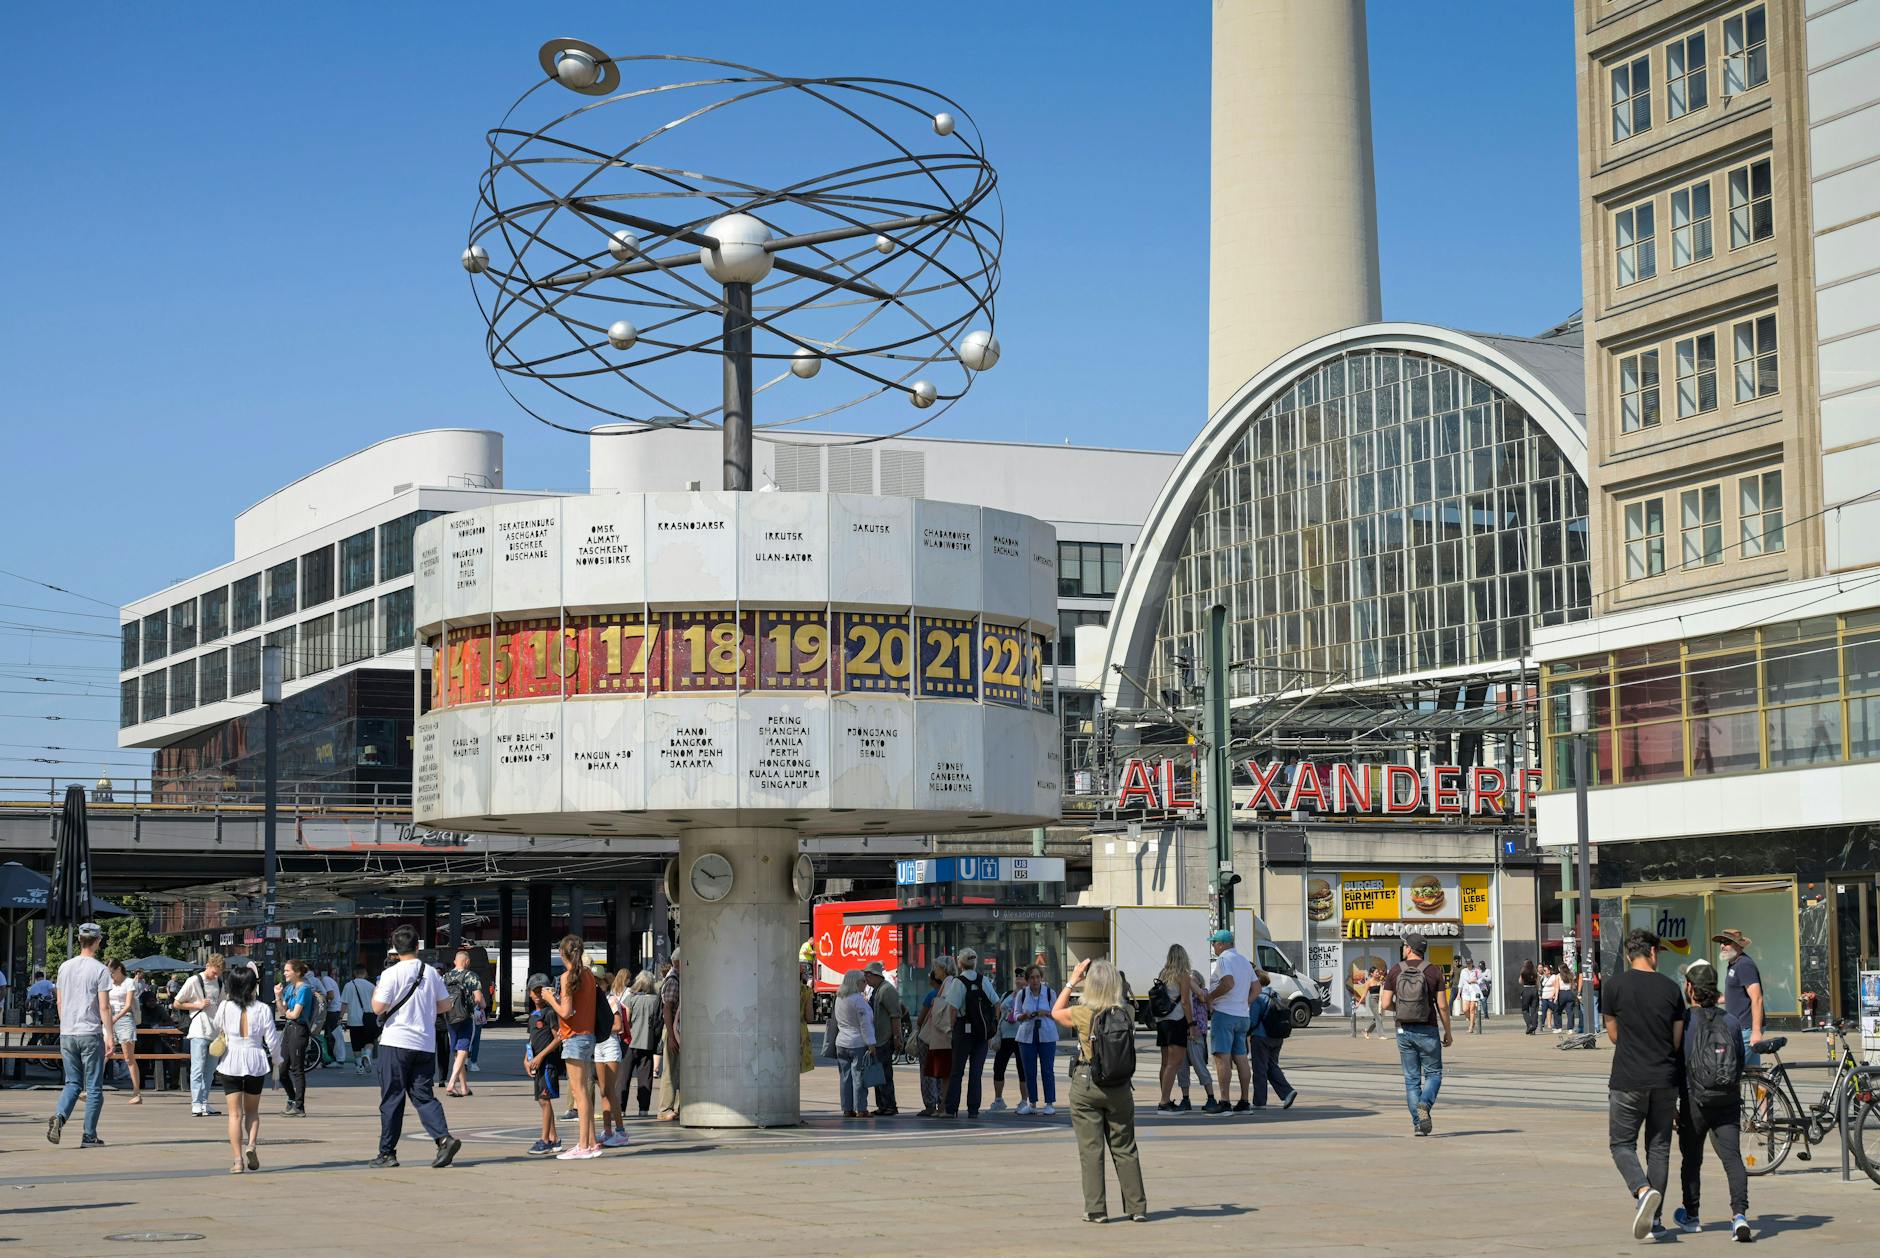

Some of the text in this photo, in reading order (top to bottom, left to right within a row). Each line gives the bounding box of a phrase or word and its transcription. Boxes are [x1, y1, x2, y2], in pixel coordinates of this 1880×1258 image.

[450, 518, 474, 529] NISCHNIJ
[500, 518, 554, 531] JEKATERINBURG
[658, 521, 725, 530] KRASNOJARSK
[853, 524, 890, 533] JAKUTSK
[458, 526, 485, 538] NOWGOROD
[592, 524, 614, 534] OMSK
[506, 530, 548, 540] ASCHGABAT
[587, 535, 620, 544] ALMATY
[765, 532, 803, 541] IRKUTSK
[924, 529, 971, 541] CHABAROWSK
[510, 540, 543, 551] BISCHKEK
[579, 545, 628, 555] TASCHKENT
[924, 539, 971, 552] WLADIWOSTOK
[506, 550, 548, 562] DUSCHANBE
[576, 555, 631, 566] NOWOSIBIRSK
[755, 553, 813, 562] ULAN-BATOR
[529, 628, 580, 679] 16
[600, 624, 660, 674] 17
[683, 622, 746, 675] 18
[768, 624, 828, 674] 19
[846, 625, 911, 678] 20
[926, 629, 971, 680] 21
[478, 635, 512, 685] 15
[983, 636, 1021, 686] 22
[677, 728, 707, 736] HANOI
[759, 727, 810, 735] SHANGHAI
[848, 727, 898, 737] PJÖNGJANG
[452, 739, 468, 747] KABUL
[497, 735, 512, 743] NEW
[516, 733, 537, 742] DELHI
[670, 738, 713, 747] BANGKOK
[766, 738, 803, 746] MANILA
[453, 747, 480, 757] MAURITIUS
[509, 744, 543, 752] KARACHI
[574, 752, 610, 760] RANGUN
[661, 749, 723, 758] PHNOM PENH
[860, 750, 886, 758] SEOUL
[500, 754, 532, 764] COLOMBO
[670, 760, 713, 768] JAKARTA
[588, 762, 619, 770] DHAKA
[938, 762, 964, 770] SYDNEY
[750, 770, 820, 778] KUALA LUMPUR
[931, 772, 970, 781] CANBERRA
[761, 780, 807, 789] SINGAPUR
[929, 782, 972, 792] MELBOURNE
[960, 858, 976, 879] U
[1016, 860, 1027, 868] U8
[898, 863, 905, 883] U
[1344, 880, 1383, 891] BURGER
[1364, 890, 1396, 900] MITTE?
[1464, 895, 1485, 903] LIEBE
[1345, 901, 1374, 910] BITTE!
[1464, 904, 1476, 912] ES!
[993, 910, 999, 918] U
[1657, 910, 1685, 937] dm
[1370, 922, 1458, 936] McDonald's
[220, 933, 234, 946] DEPOT
